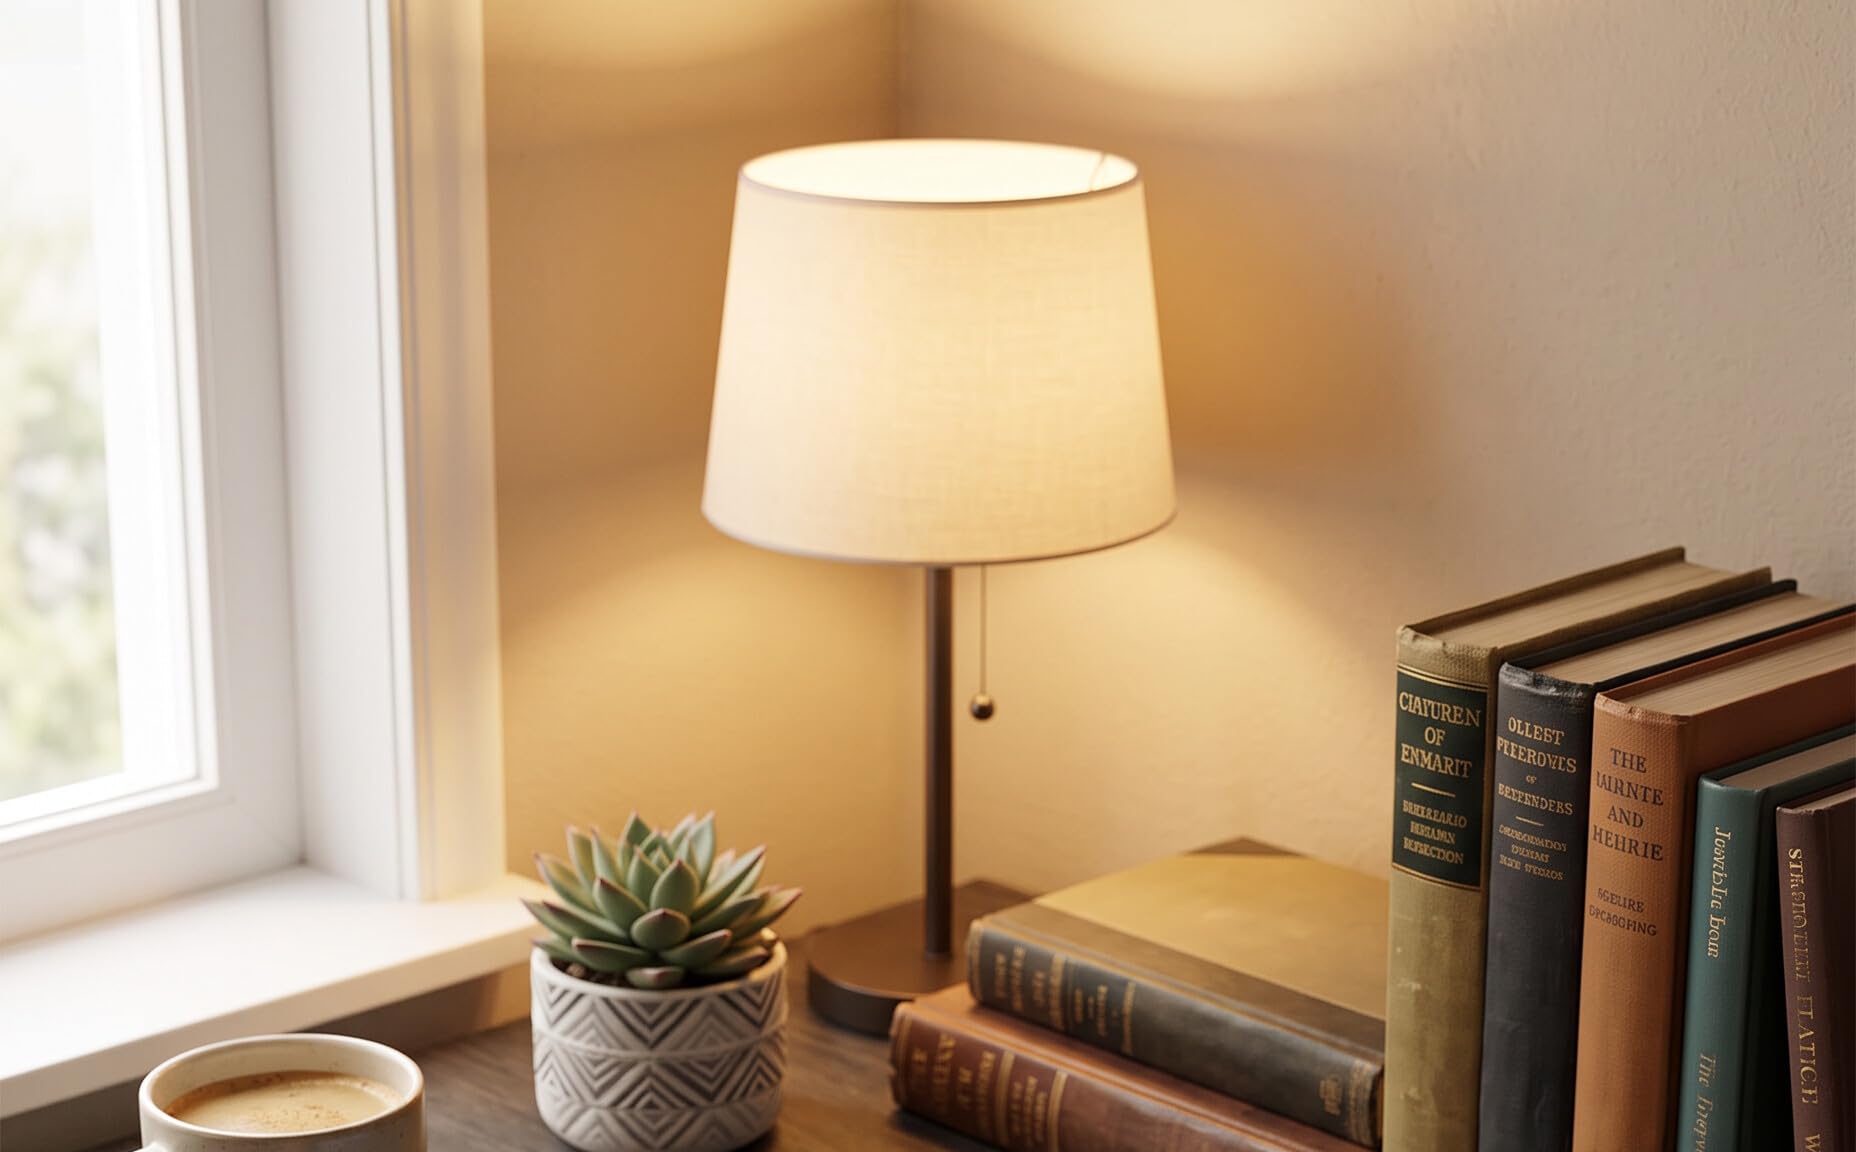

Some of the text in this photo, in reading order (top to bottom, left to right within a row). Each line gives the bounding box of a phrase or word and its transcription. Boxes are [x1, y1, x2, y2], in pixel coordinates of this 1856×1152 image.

[1424, 726, 1446, 746] OF
[1610, 747, 1648, 774] THE
[1607, 805, 1644, 829] AND
